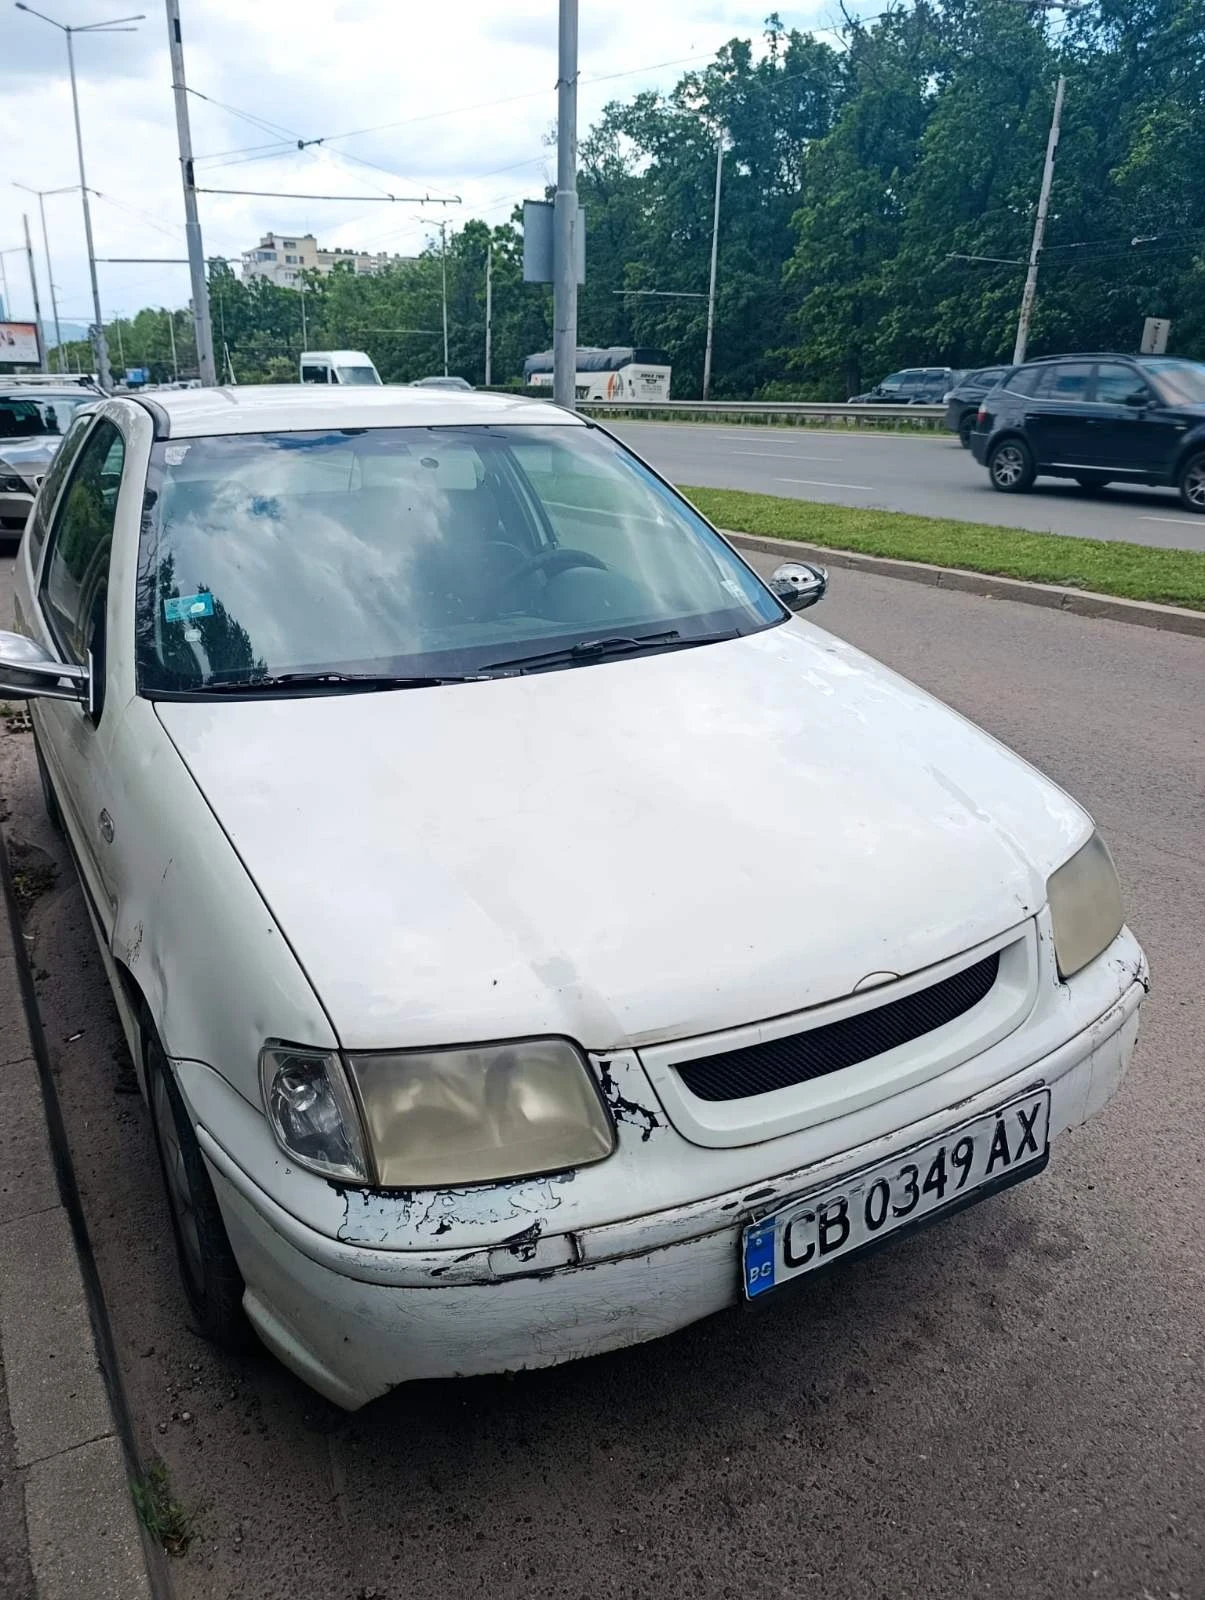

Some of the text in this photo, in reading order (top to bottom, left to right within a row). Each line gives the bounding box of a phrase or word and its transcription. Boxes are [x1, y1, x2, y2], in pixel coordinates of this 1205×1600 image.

[783, 1102, 1042, 1269] CB 0349 AX
[749, 1261, 772, 1284] BG
